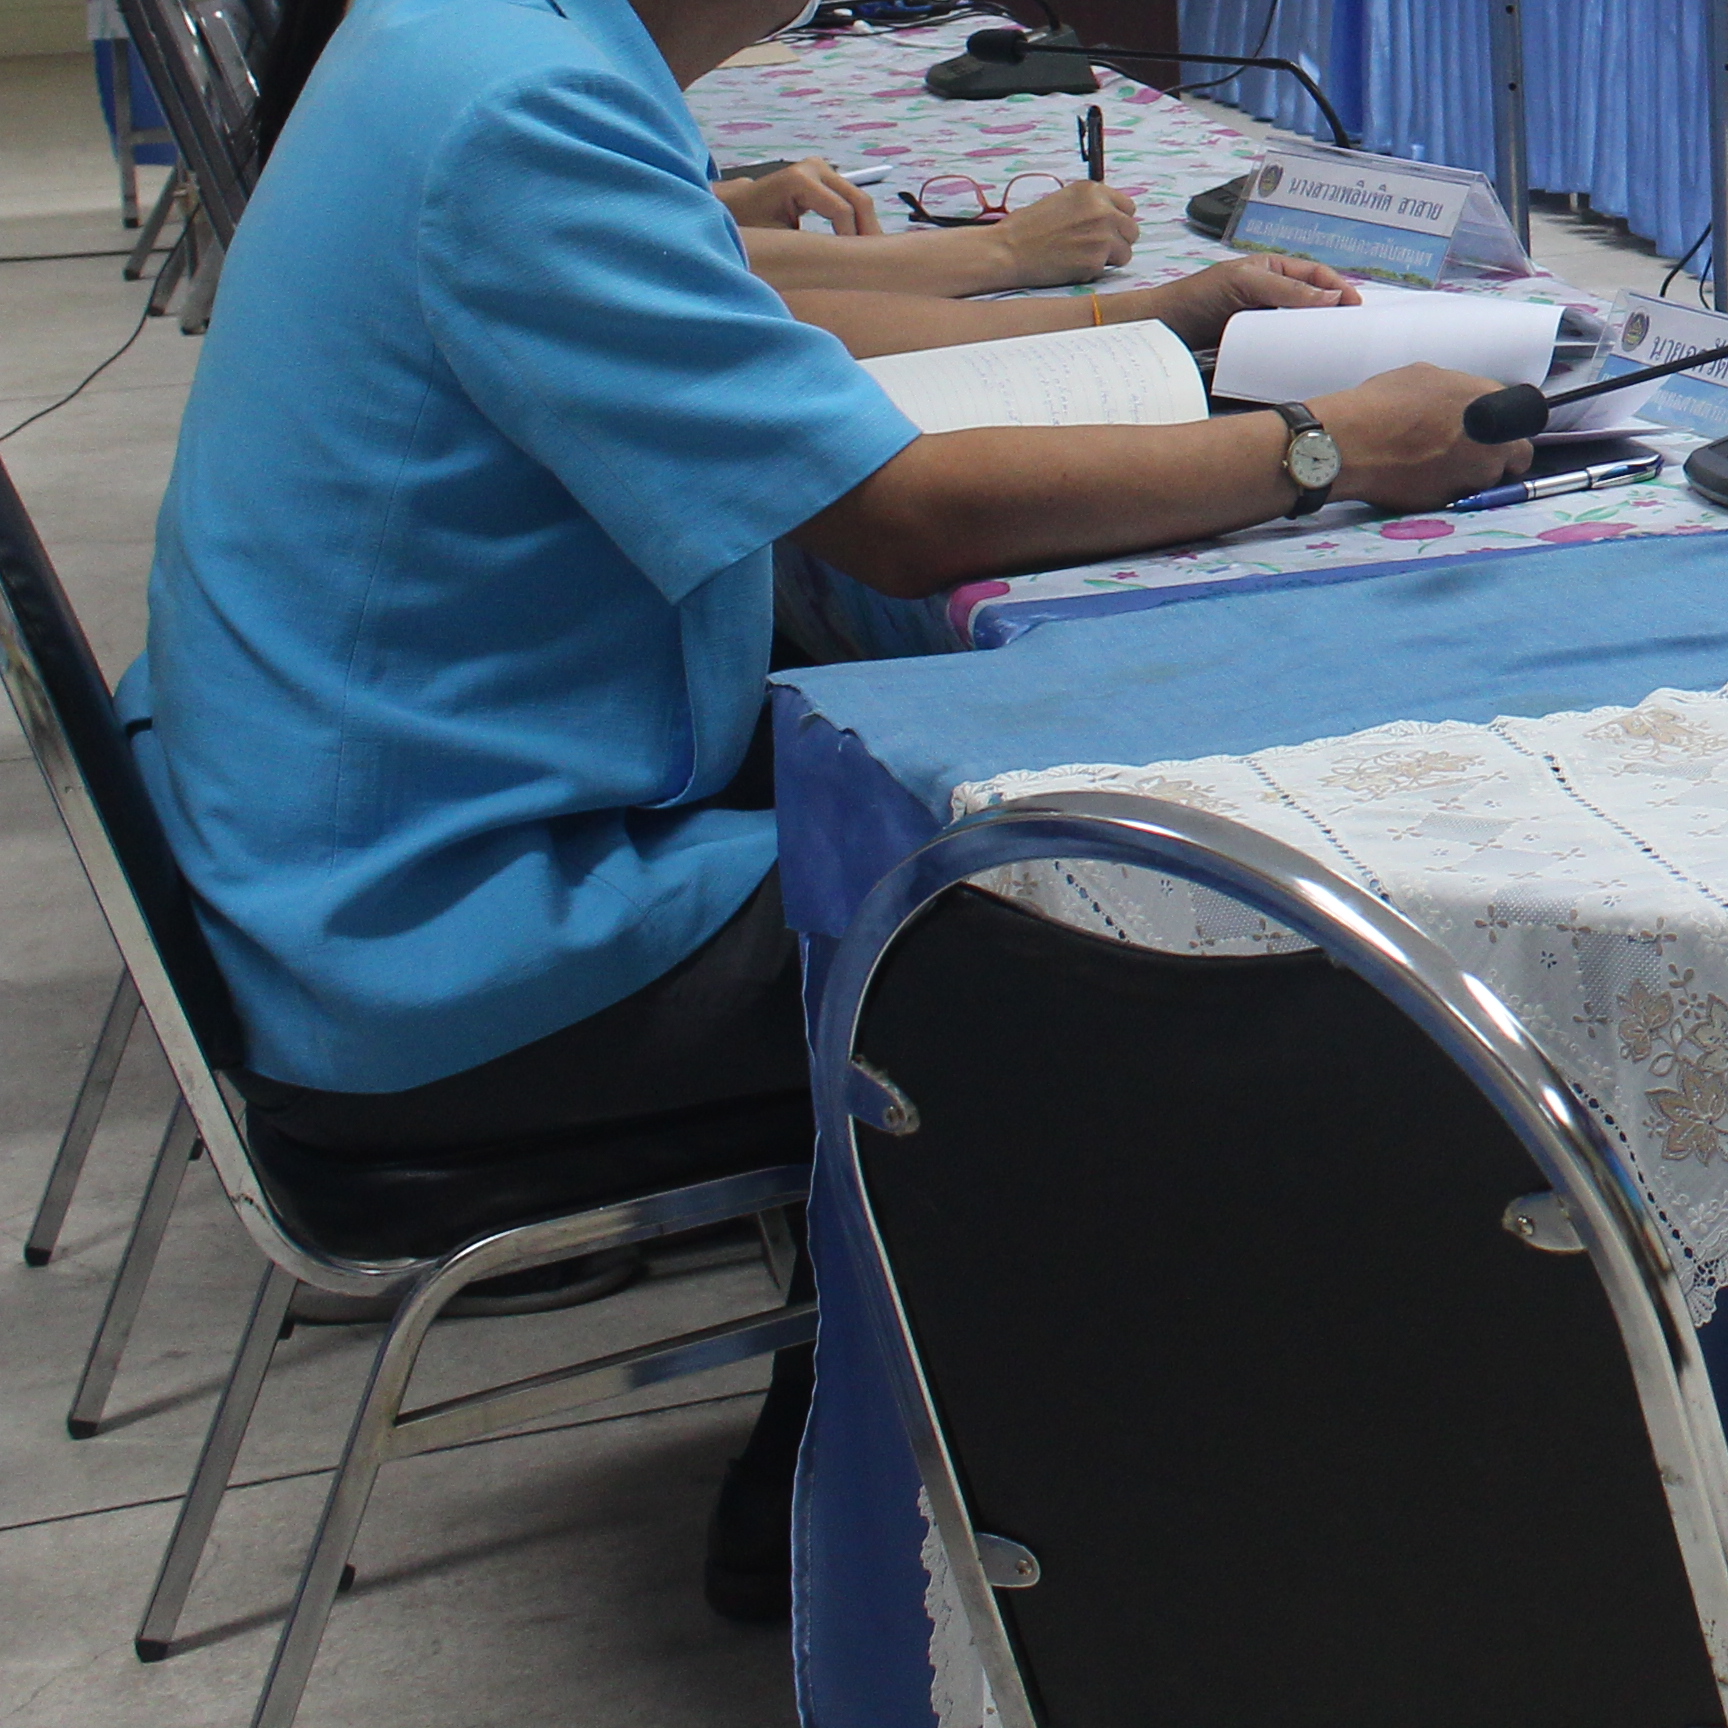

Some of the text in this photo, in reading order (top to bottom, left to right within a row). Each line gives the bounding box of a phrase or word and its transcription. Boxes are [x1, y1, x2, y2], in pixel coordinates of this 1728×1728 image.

[1287, 176, 1394, 213] นางสาวเพลินพิศ
